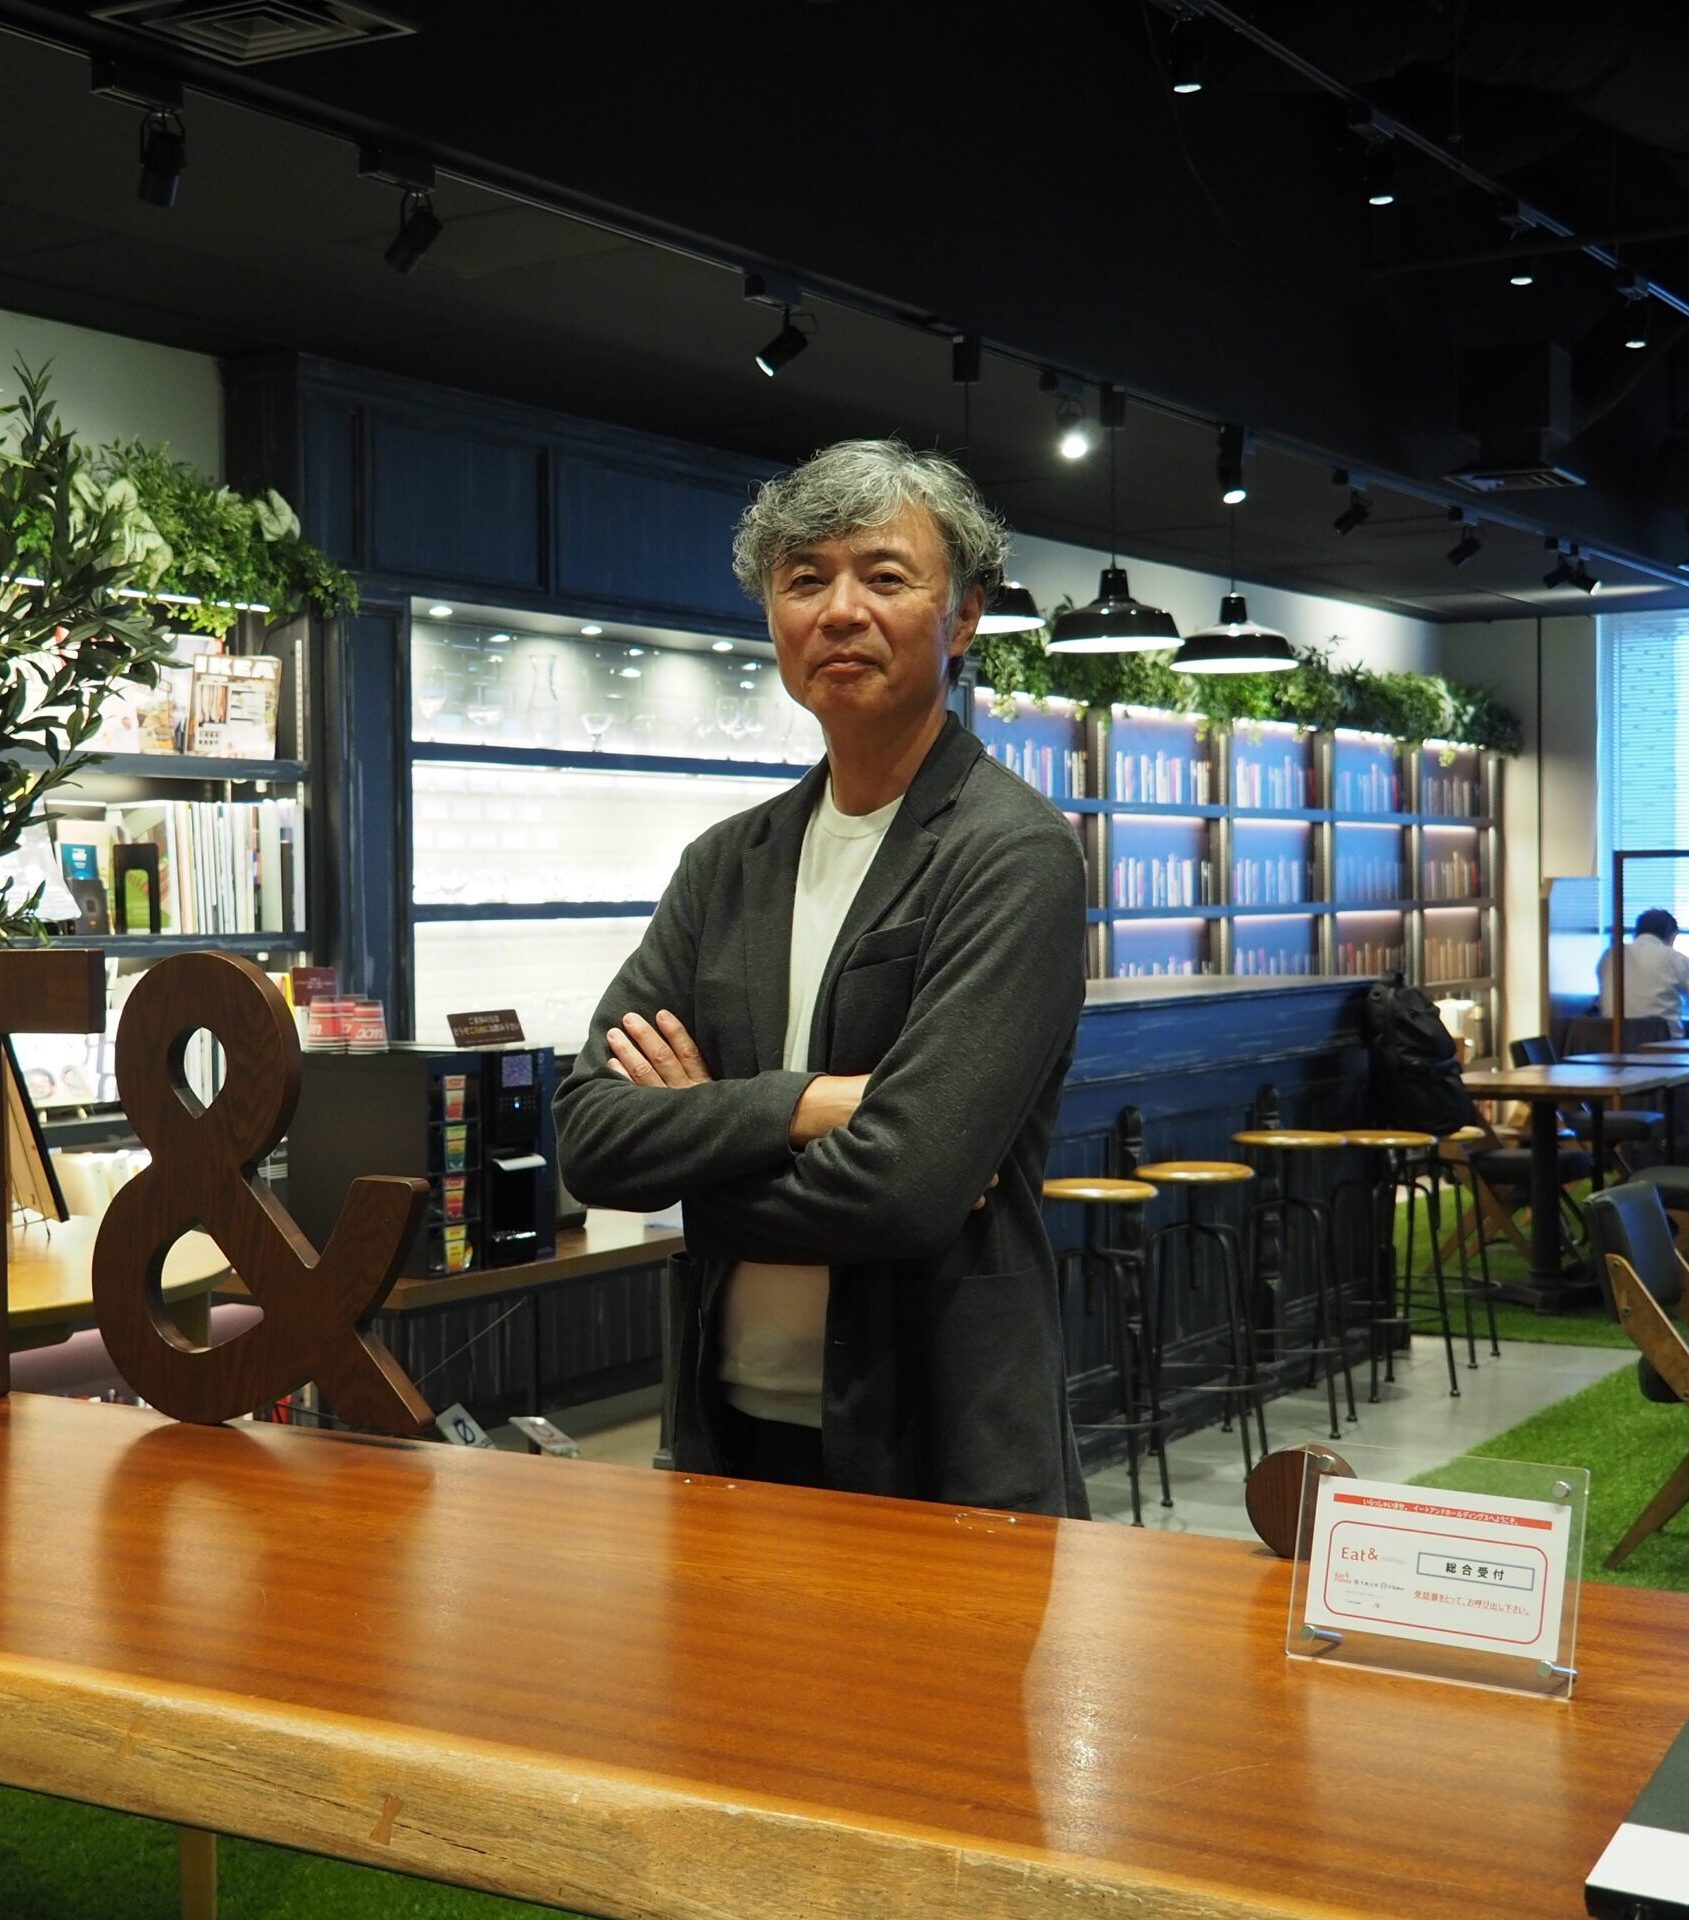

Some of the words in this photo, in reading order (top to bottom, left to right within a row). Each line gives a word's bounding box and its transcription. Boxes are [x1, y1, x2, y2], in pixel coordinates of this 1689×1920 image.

[194, 655, 276, 679] IKEA
[1445, 1562, 1505, 1581] 総合受付
